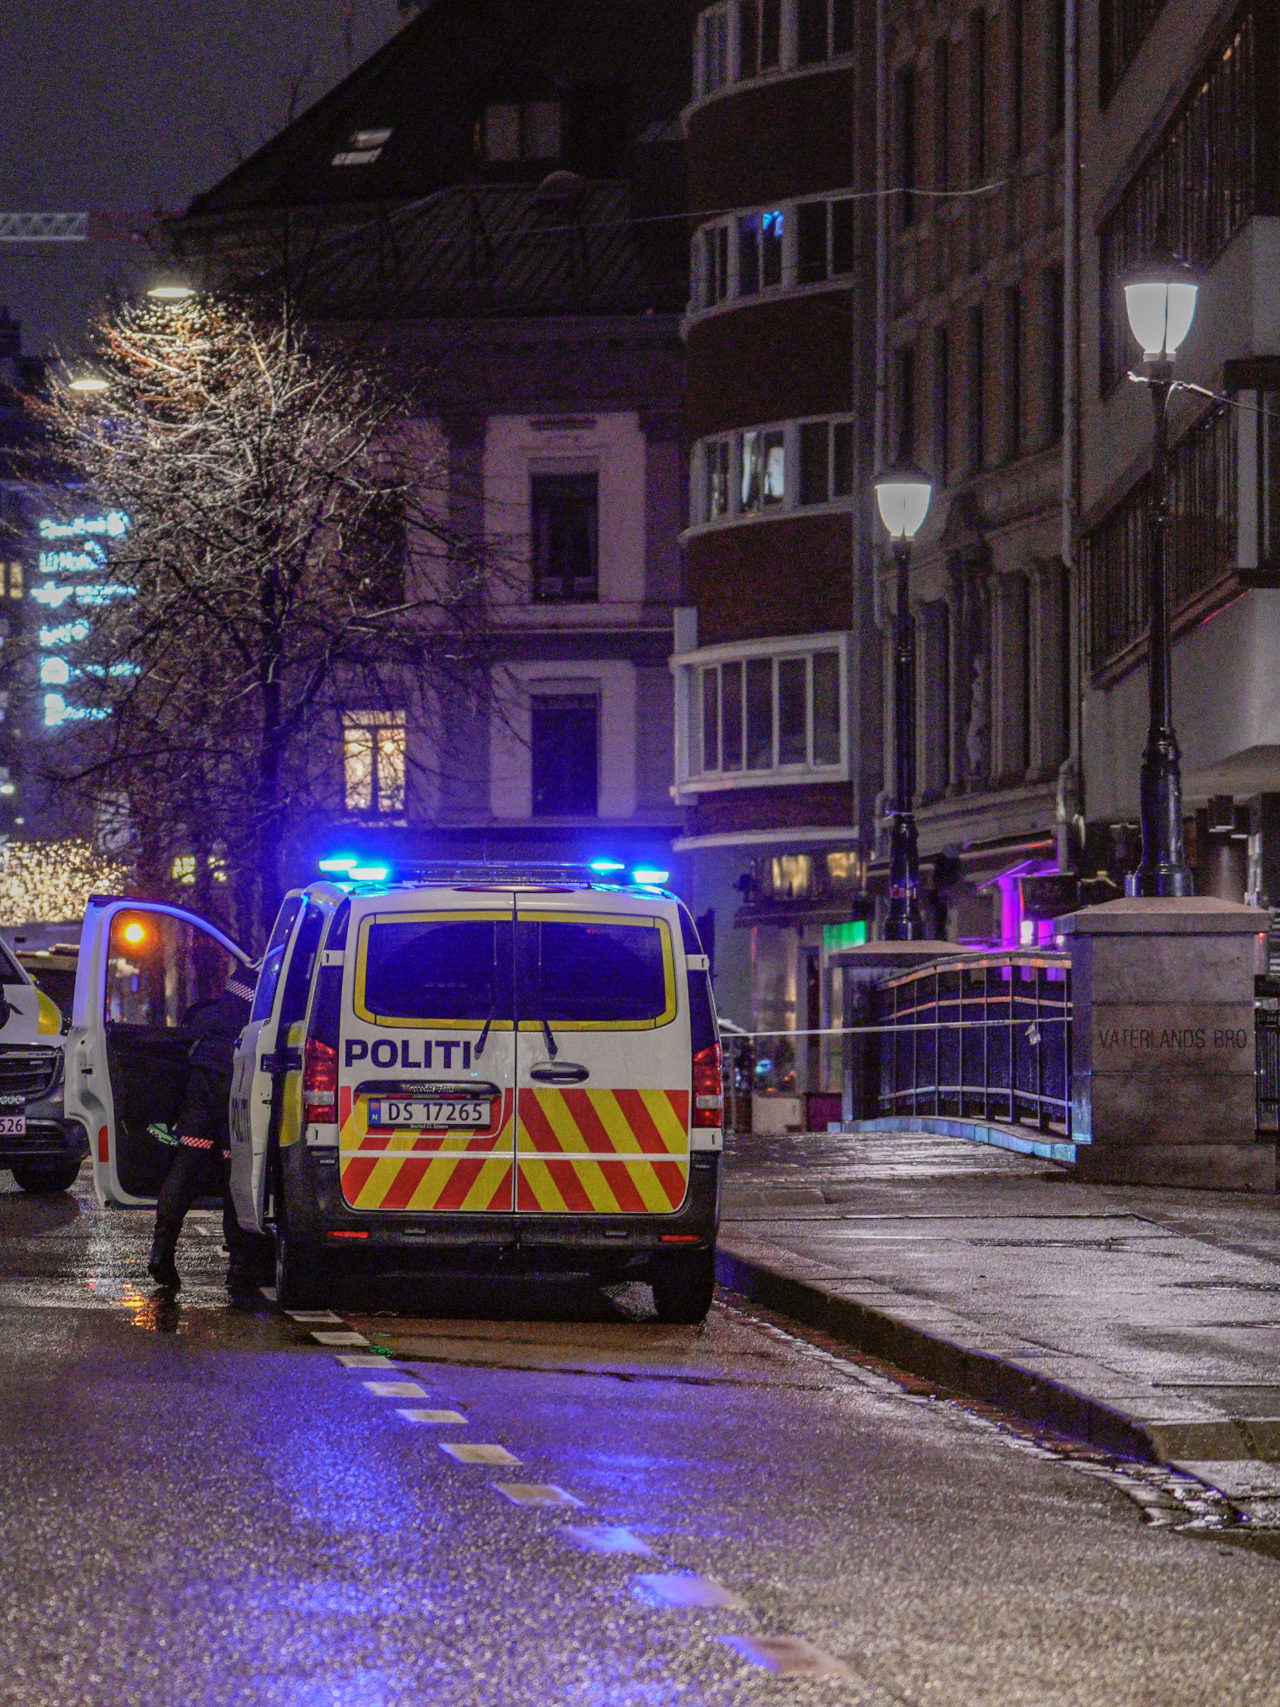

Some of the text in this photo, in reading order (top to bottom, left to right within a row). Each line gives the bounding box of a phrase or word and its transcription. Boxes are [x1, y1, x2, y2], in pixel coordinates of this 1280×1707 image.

[1098, 1028, 1248, 1049] VATERLANDS BRO
[345, 1039, 472, 1069] POLITI
[388, 1102, 413, 1121] DS
[423, 1102, 482, 1121] 17265
